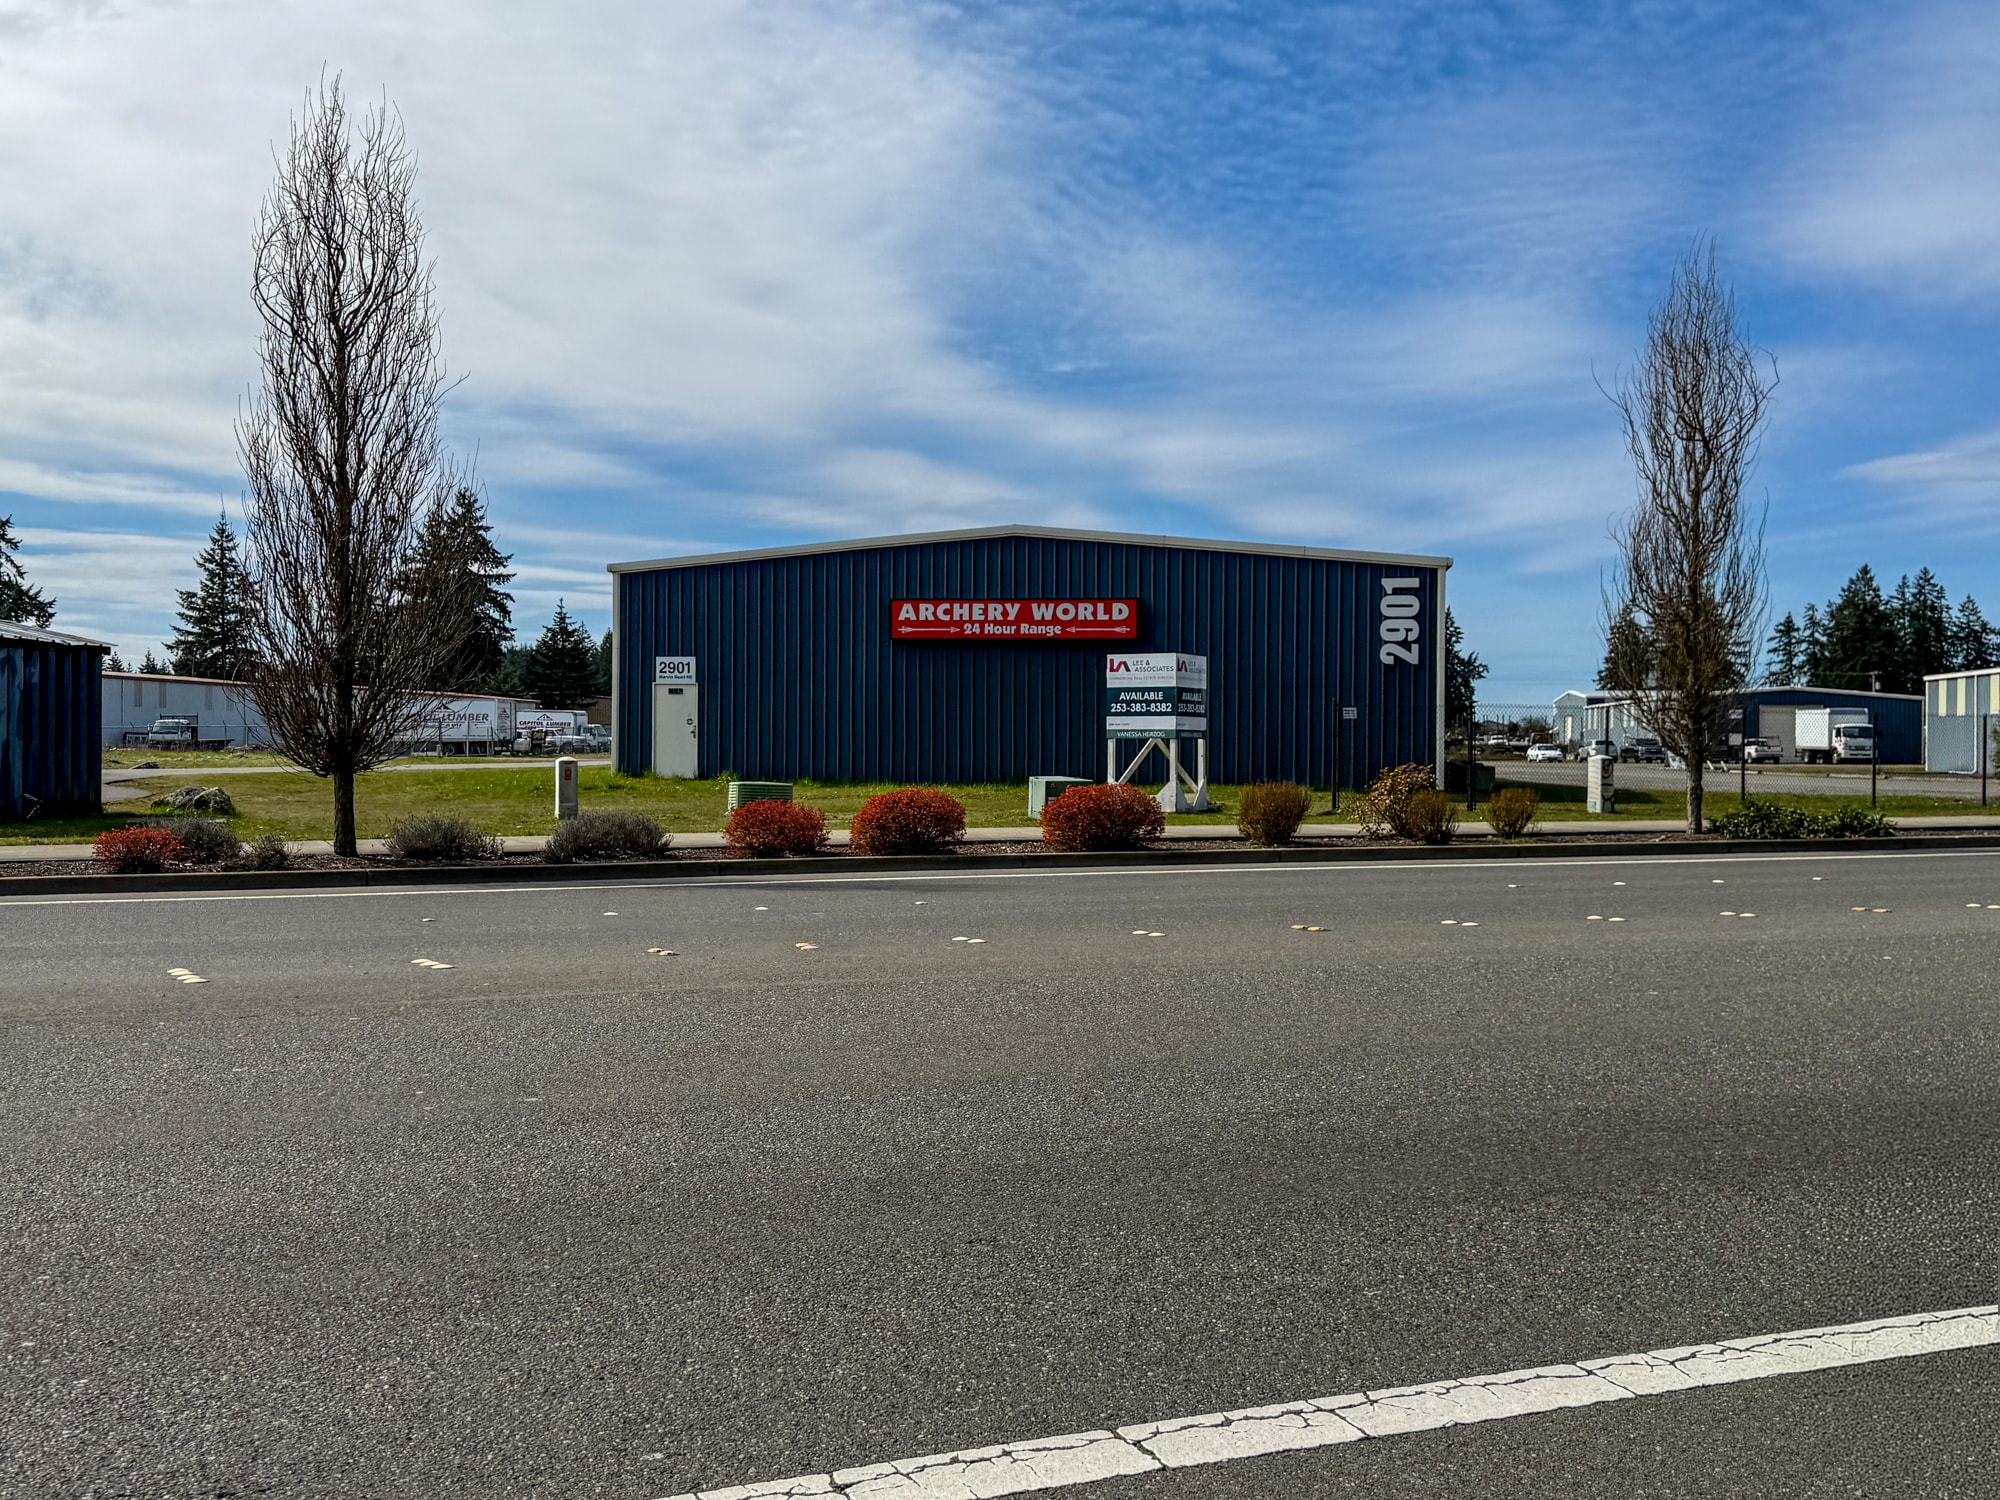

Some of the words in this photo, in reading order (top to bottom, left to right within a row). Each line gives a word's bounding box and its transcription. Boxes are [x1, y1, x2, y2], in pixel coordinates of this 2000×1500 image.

[898, 603, 1021, 621] ARCHERY
[1031, 602, 1129, 621] WORLD
[1380, 577, 1420, 665] 2901
[963, 624, 980, 634] 24
[984, 623, 1016, 634] Hour
[1020, 623, 1062, 636] Range
[659, 661, 691, 674] 2901
[1119, 691, 1164, 701] AVAILABLE
[1182, 692, 1202, 701] AVAILABLE
[1110, 702, 1172, 712] 253-383-8382
[441, 713, 489, 722] LUMBER
